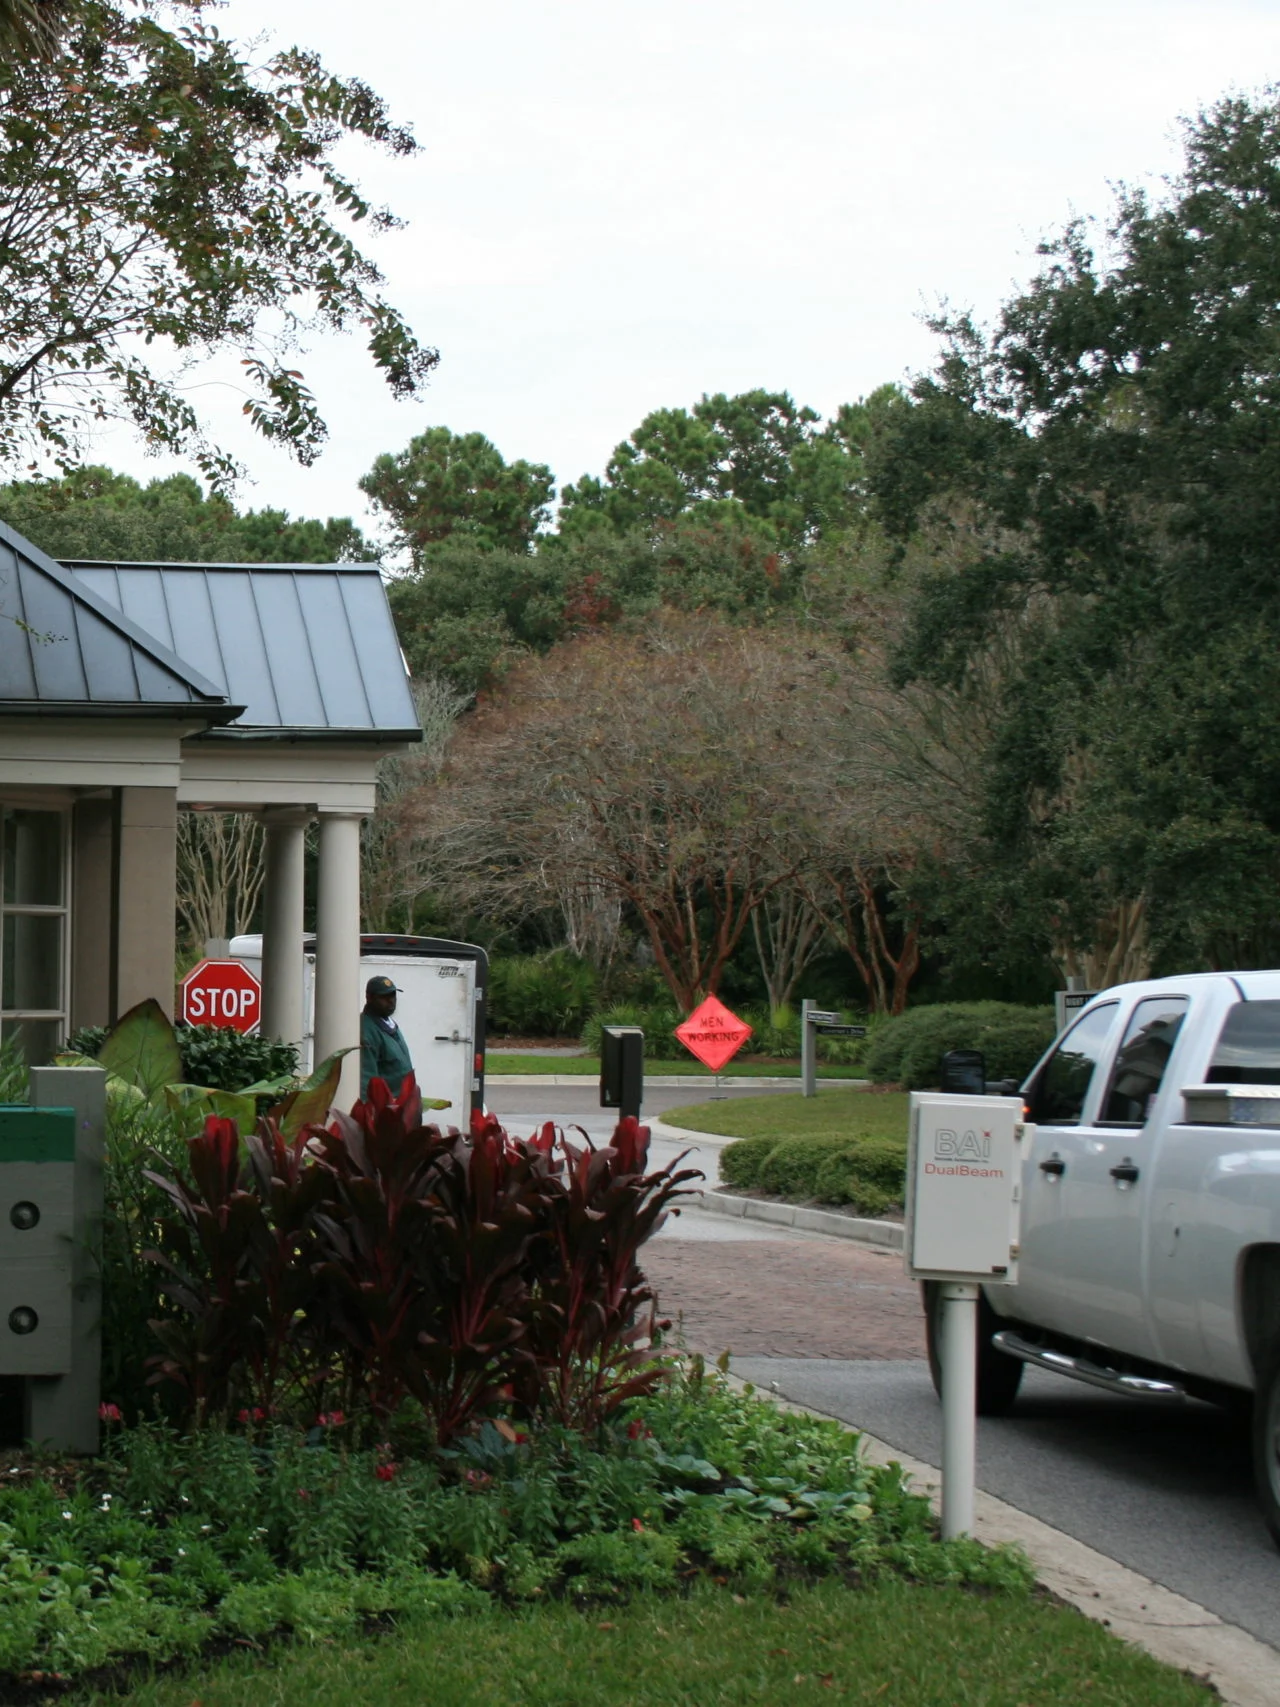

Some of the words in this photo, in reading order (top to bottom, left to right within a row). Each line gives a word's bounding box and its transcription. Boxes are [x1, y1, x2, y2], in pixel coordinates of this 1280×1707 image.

[190, 988, 256, 1017] STOP
[700, 1017, 724, 1027] MEN
[688, 1032, 740, 1042] WORKING
[924, 1163, 1004, 1178] DualBeam
